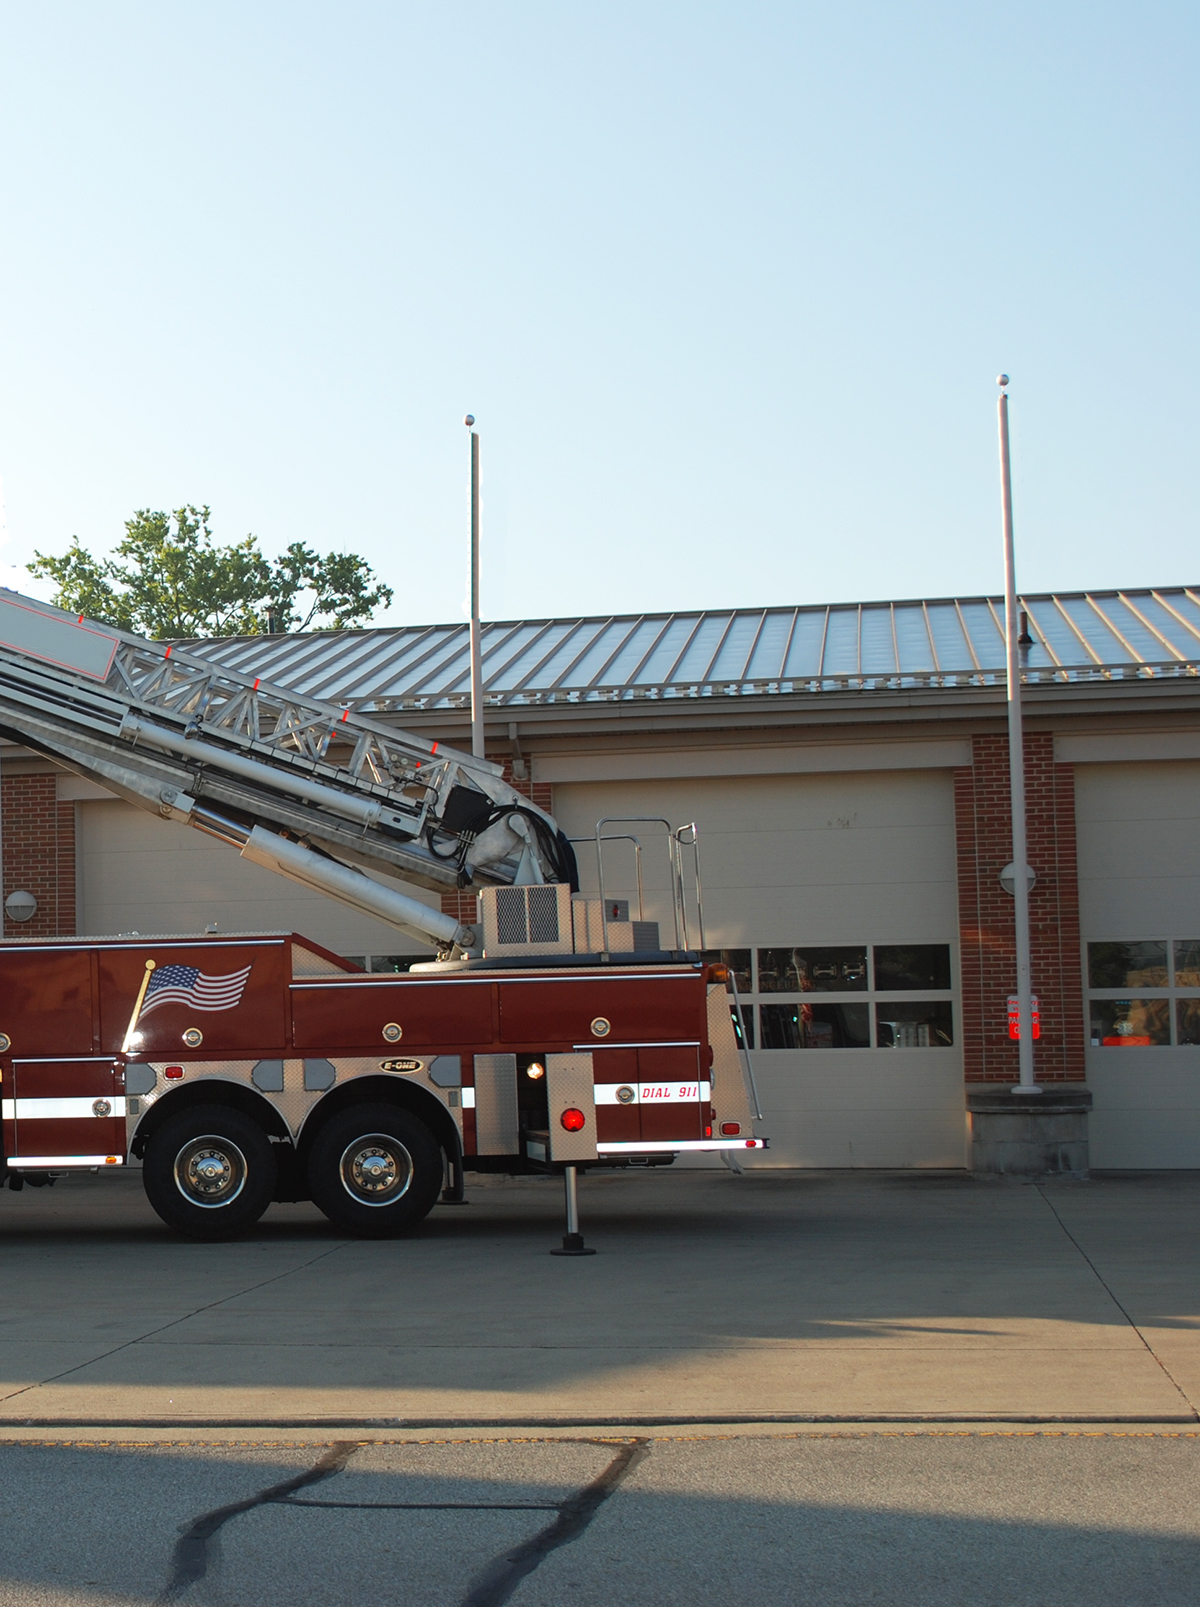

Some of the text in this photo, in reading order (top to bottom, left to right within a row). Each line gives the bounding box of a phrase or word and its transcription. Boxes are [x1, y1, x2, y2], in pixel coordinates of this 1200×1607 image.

[384, 1061, 416, 1070] E-ONE
[642, 1086, 697, 1098] DIAL 911
